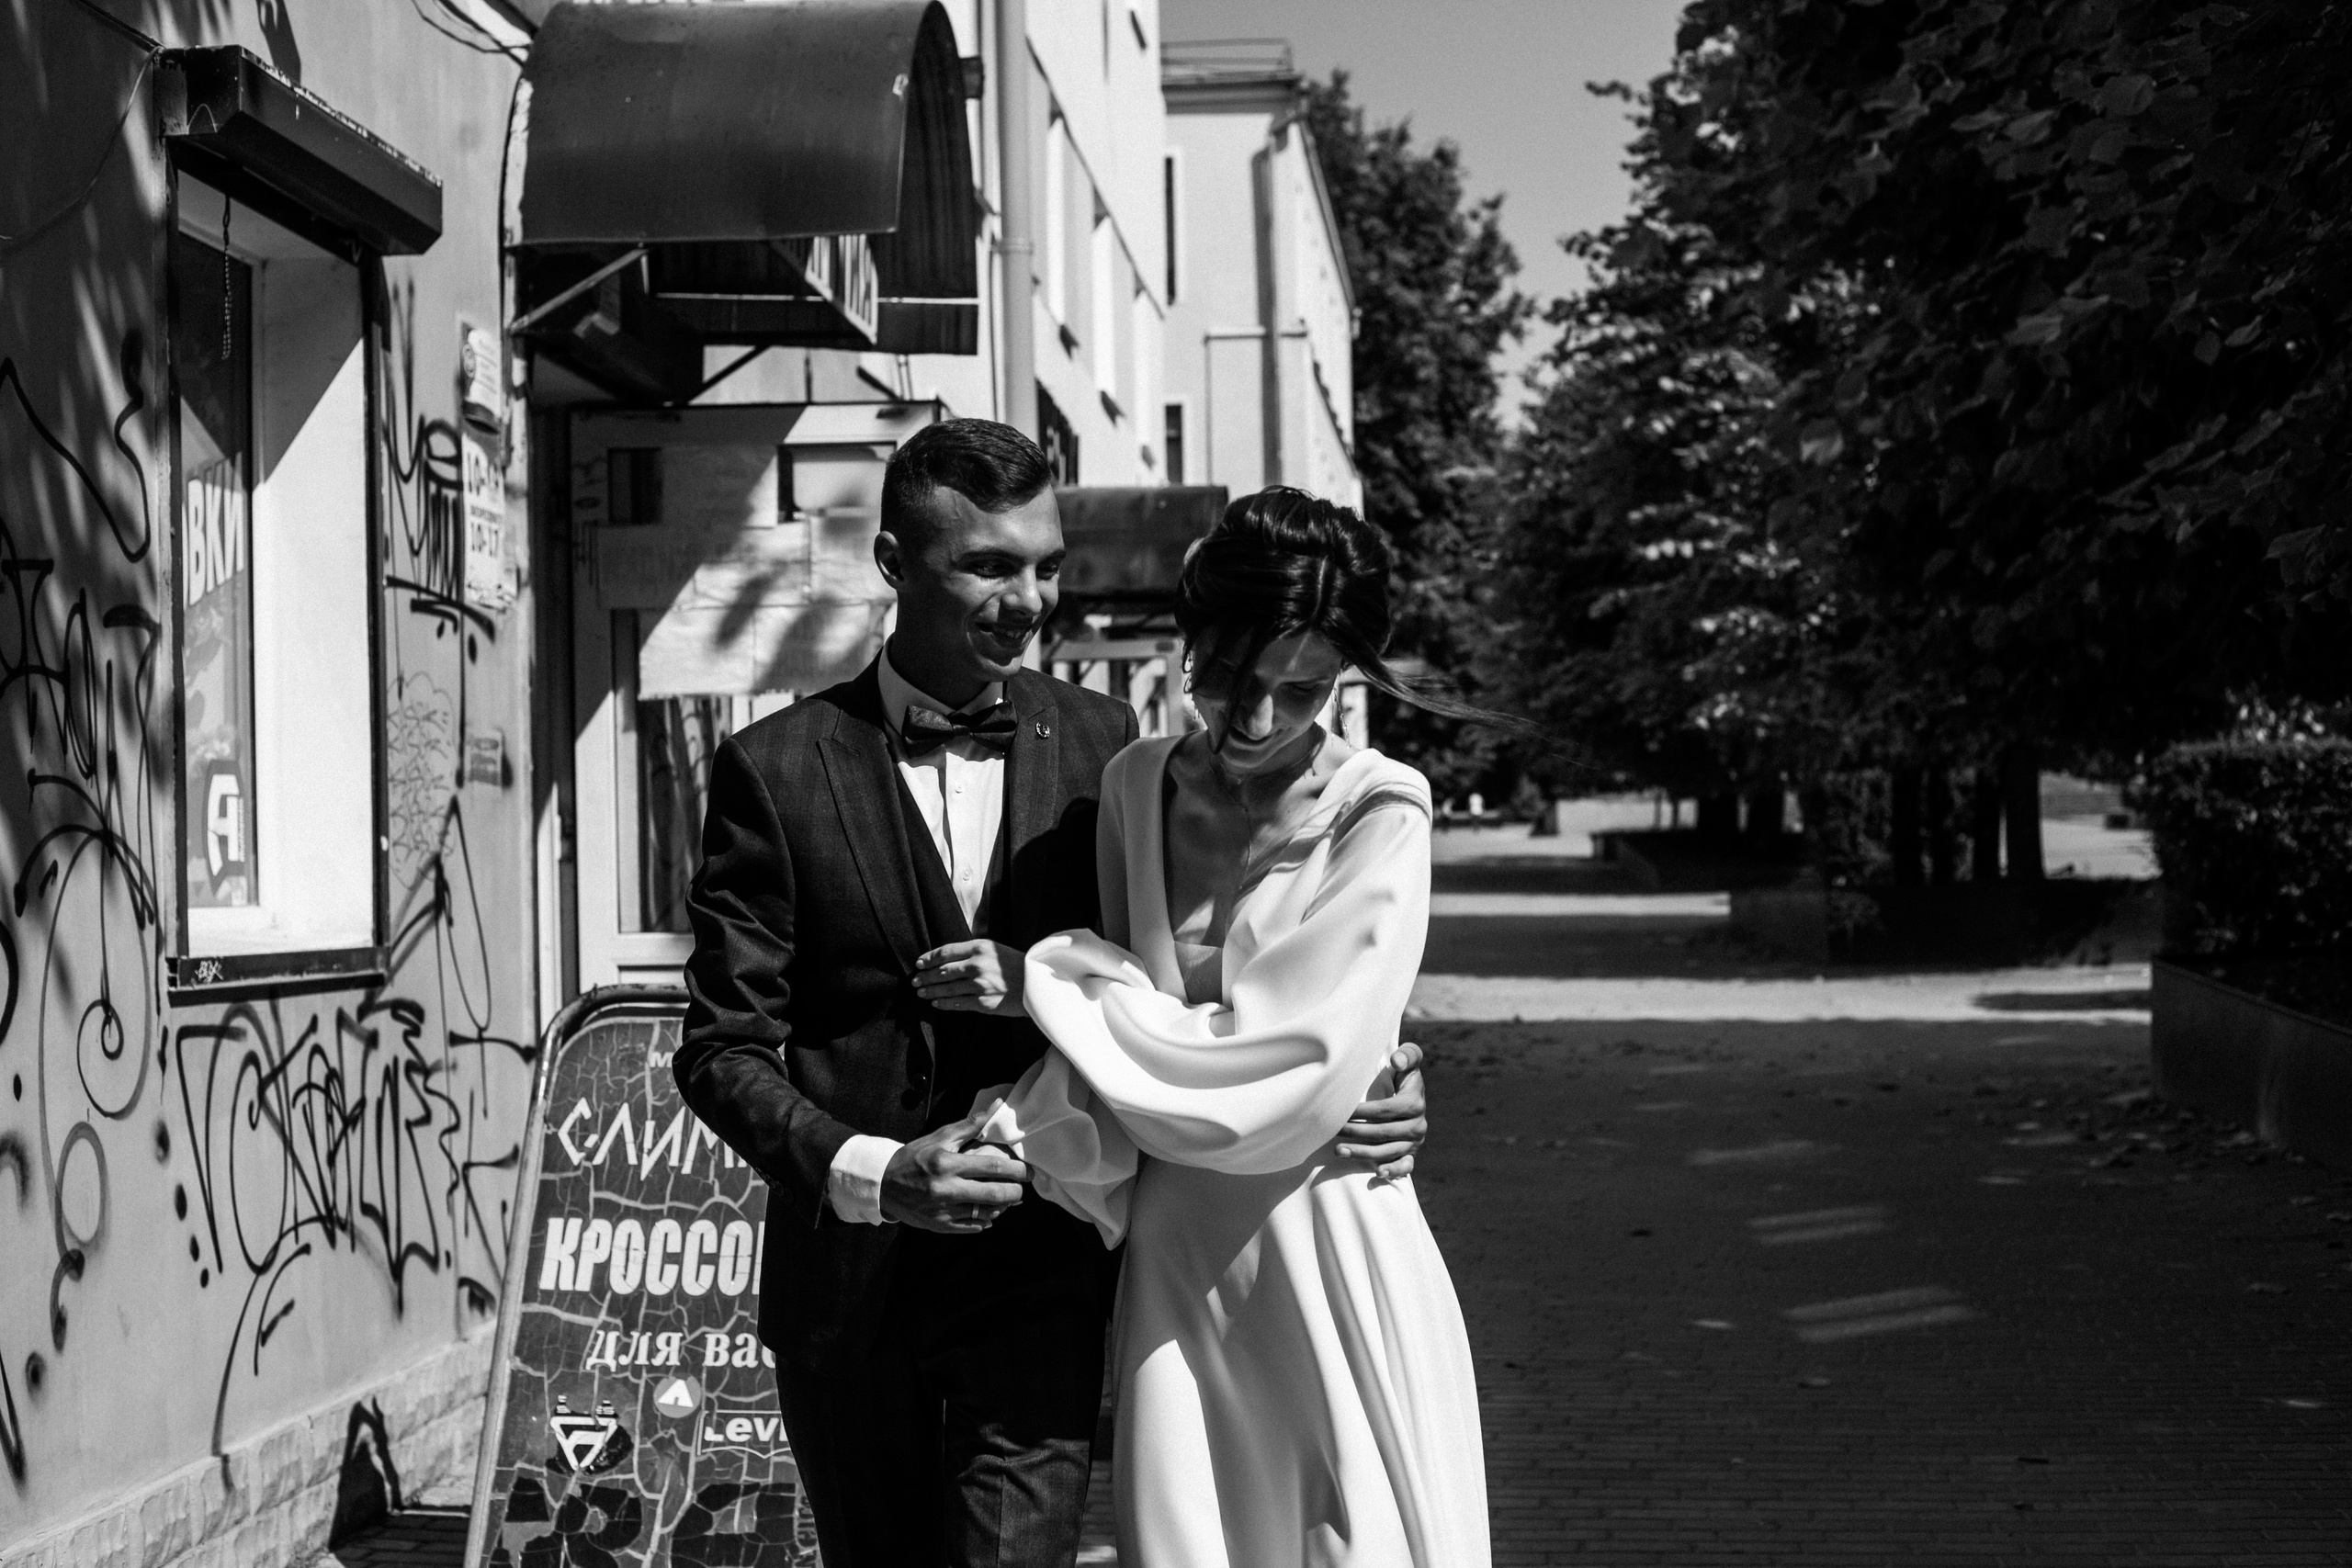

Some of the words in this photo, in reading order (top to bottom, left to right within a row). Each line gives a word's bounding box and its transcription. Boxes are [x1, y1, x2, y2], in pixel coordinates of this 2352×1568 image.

[182, 451, 244, 613] ВКИ
[539, 1217, 765, 1296] КРОССО
[585, 1330, 684, 1372] для
